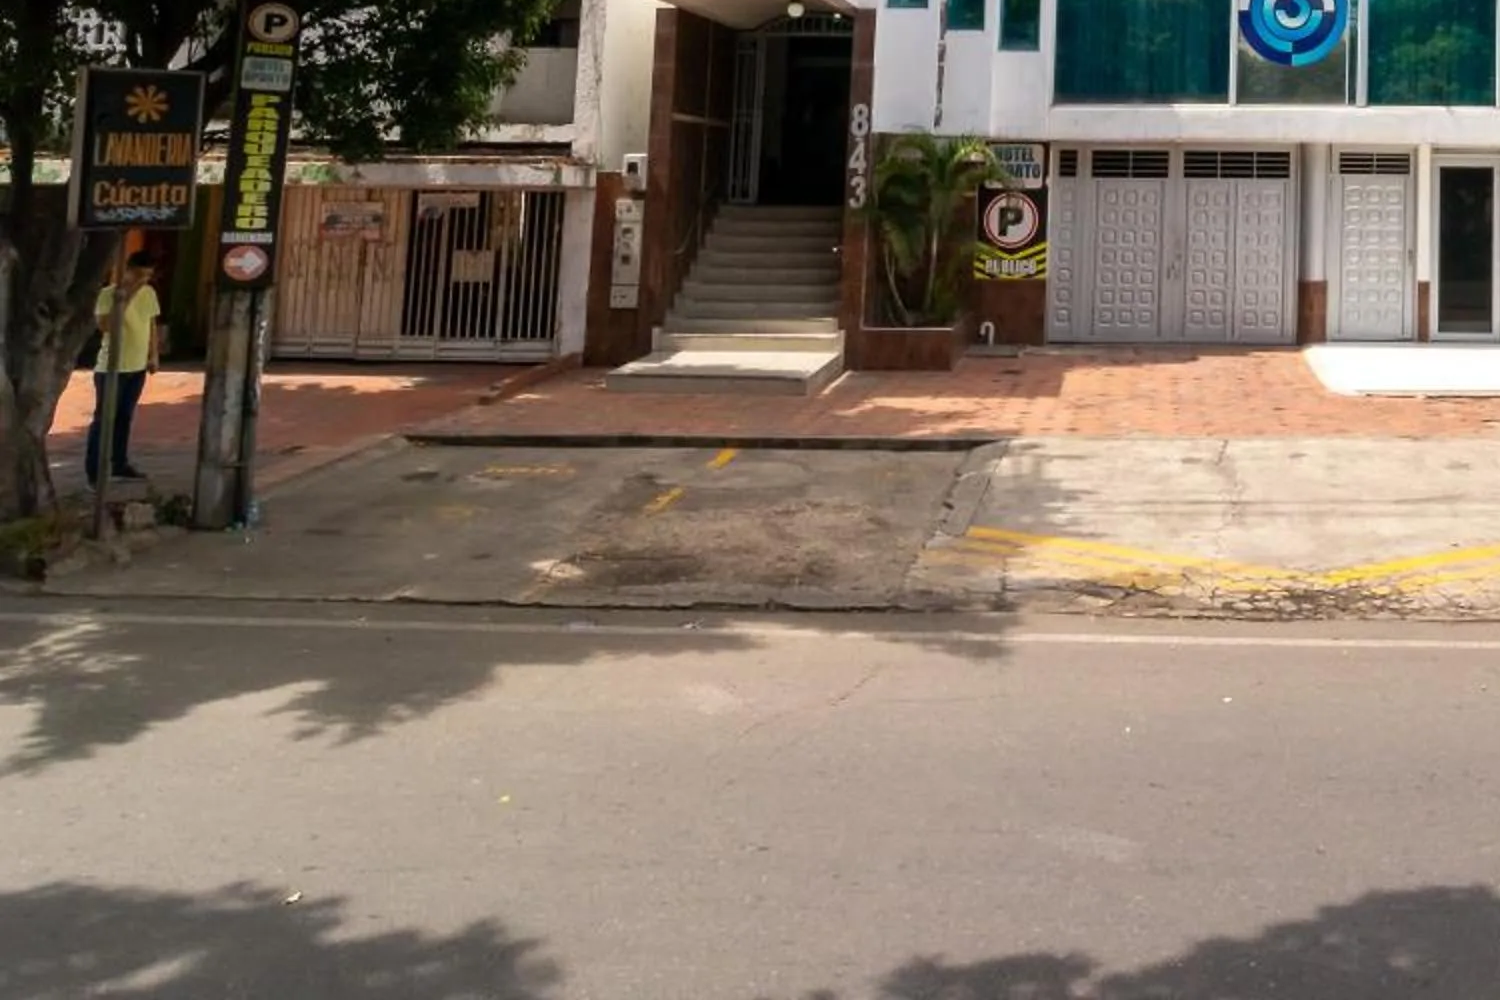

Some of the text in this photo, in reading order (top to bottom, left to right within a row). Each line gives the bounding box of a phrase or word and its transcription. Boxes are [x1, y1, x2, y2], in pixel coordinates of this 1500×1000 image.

[263, 13, 288, 34] P
[235, 94, 281, 229] PARQUEADERO
[849, 103, 869, 208] 843
[997, 207, 1024, 237] P
